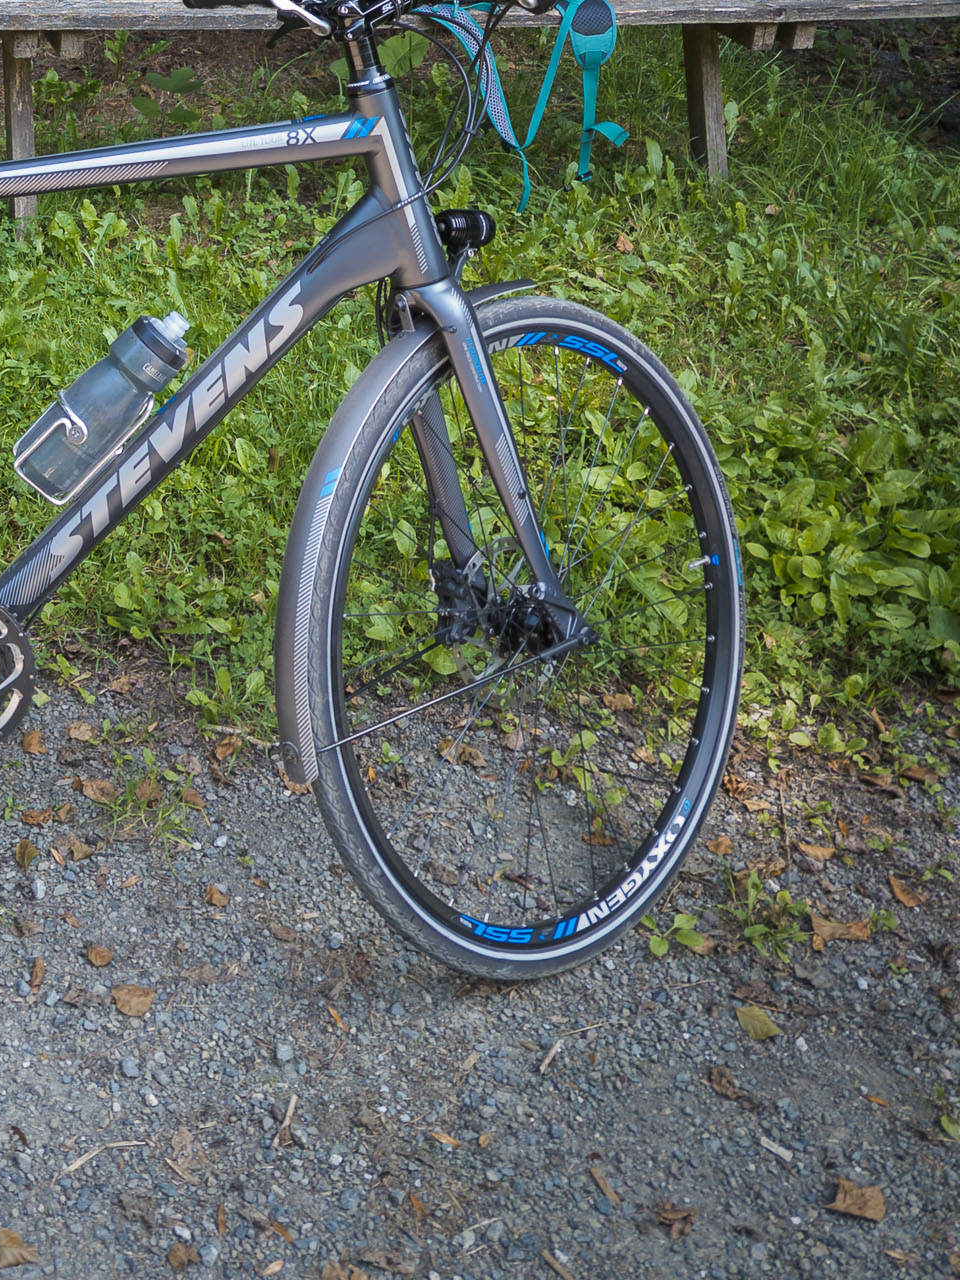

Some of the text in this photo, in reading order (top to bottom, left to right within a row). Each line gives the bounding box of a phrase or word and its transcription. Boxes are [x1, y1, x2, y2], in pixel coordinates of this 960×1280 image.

[286, 127, 318, 146] 8X
[558, 335, 624, 373] SSL
[50, 281, 303, 579] STEVENS
[589, 815, 686, 925] OXYGEN
[460, 913, 534, 944] SSL
